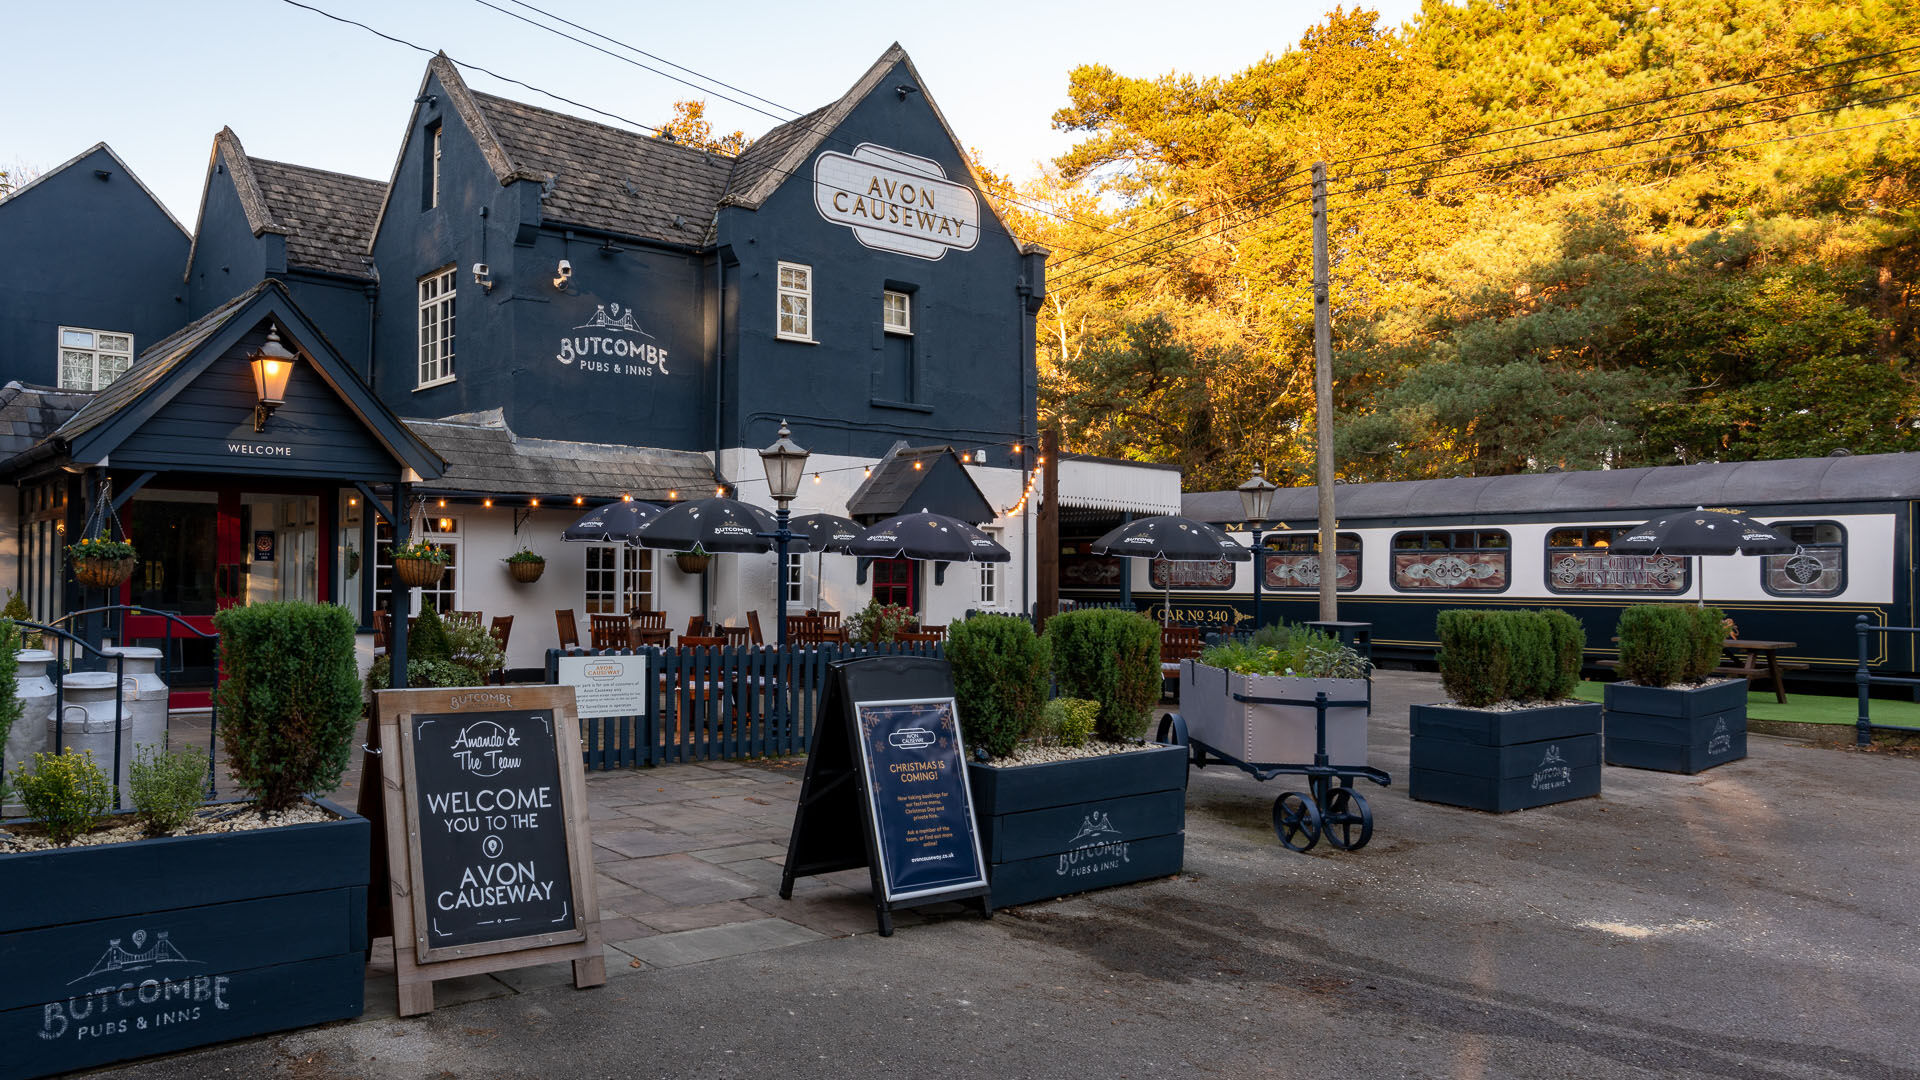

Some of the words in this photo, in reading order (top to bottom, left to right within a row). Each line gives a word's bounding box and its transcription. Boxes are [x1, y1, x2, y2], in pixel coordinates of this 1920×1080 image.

[868, 176, 935, 210] AVON
[833, 191, 965, 238] CAUSEWAY
[556, 337, 669, 375] BUTCOMBE
[580, 360, 610, 372] PUBS
[614, 363, 621, 374] &
[625, 365, 653, 376] INNS
[228, 444, 291, 456] WELCOME
[714, 527, 753, 535] BUTCOMBE
[1583, 571, 1650, 584] RESTAURANT
[1157, 609, 1184, 621] CAR
[1207, 610, 1228, 622] 340
[450, 693, 512, 710] BUTCOMBE
[450, 727, 504, 749] Amanda
[507, 727, 520, 747] &
[453, 749, 482, 770] The
[484, 749, 521, 769] Team
[890, 761, 937, 773] CHRISTMAS
[901, 771, 938, 783] COMING!
[427, 786, 552, 814] WELCOME
[444, 816, 479, 832] YOU
[485, 815, 507, 830] TO
[511, 813, 538, 829] THE
[1056, 840, 1130, 876] BUTCOMBE
[1071, 865, 1091, 877] PUBS
[1101, 860, 1119, 871] INNS
[460, 860, 535, 889] AVON
[437, 880, 554, 911] CAUSEWAY
[37, 975, 231, 1040] BUTCOMBE
[78, 1019, 128, 1040] PUBS
[136, 1016, 148, 1030] &
[156, 1007, 201, 1027] INNS
